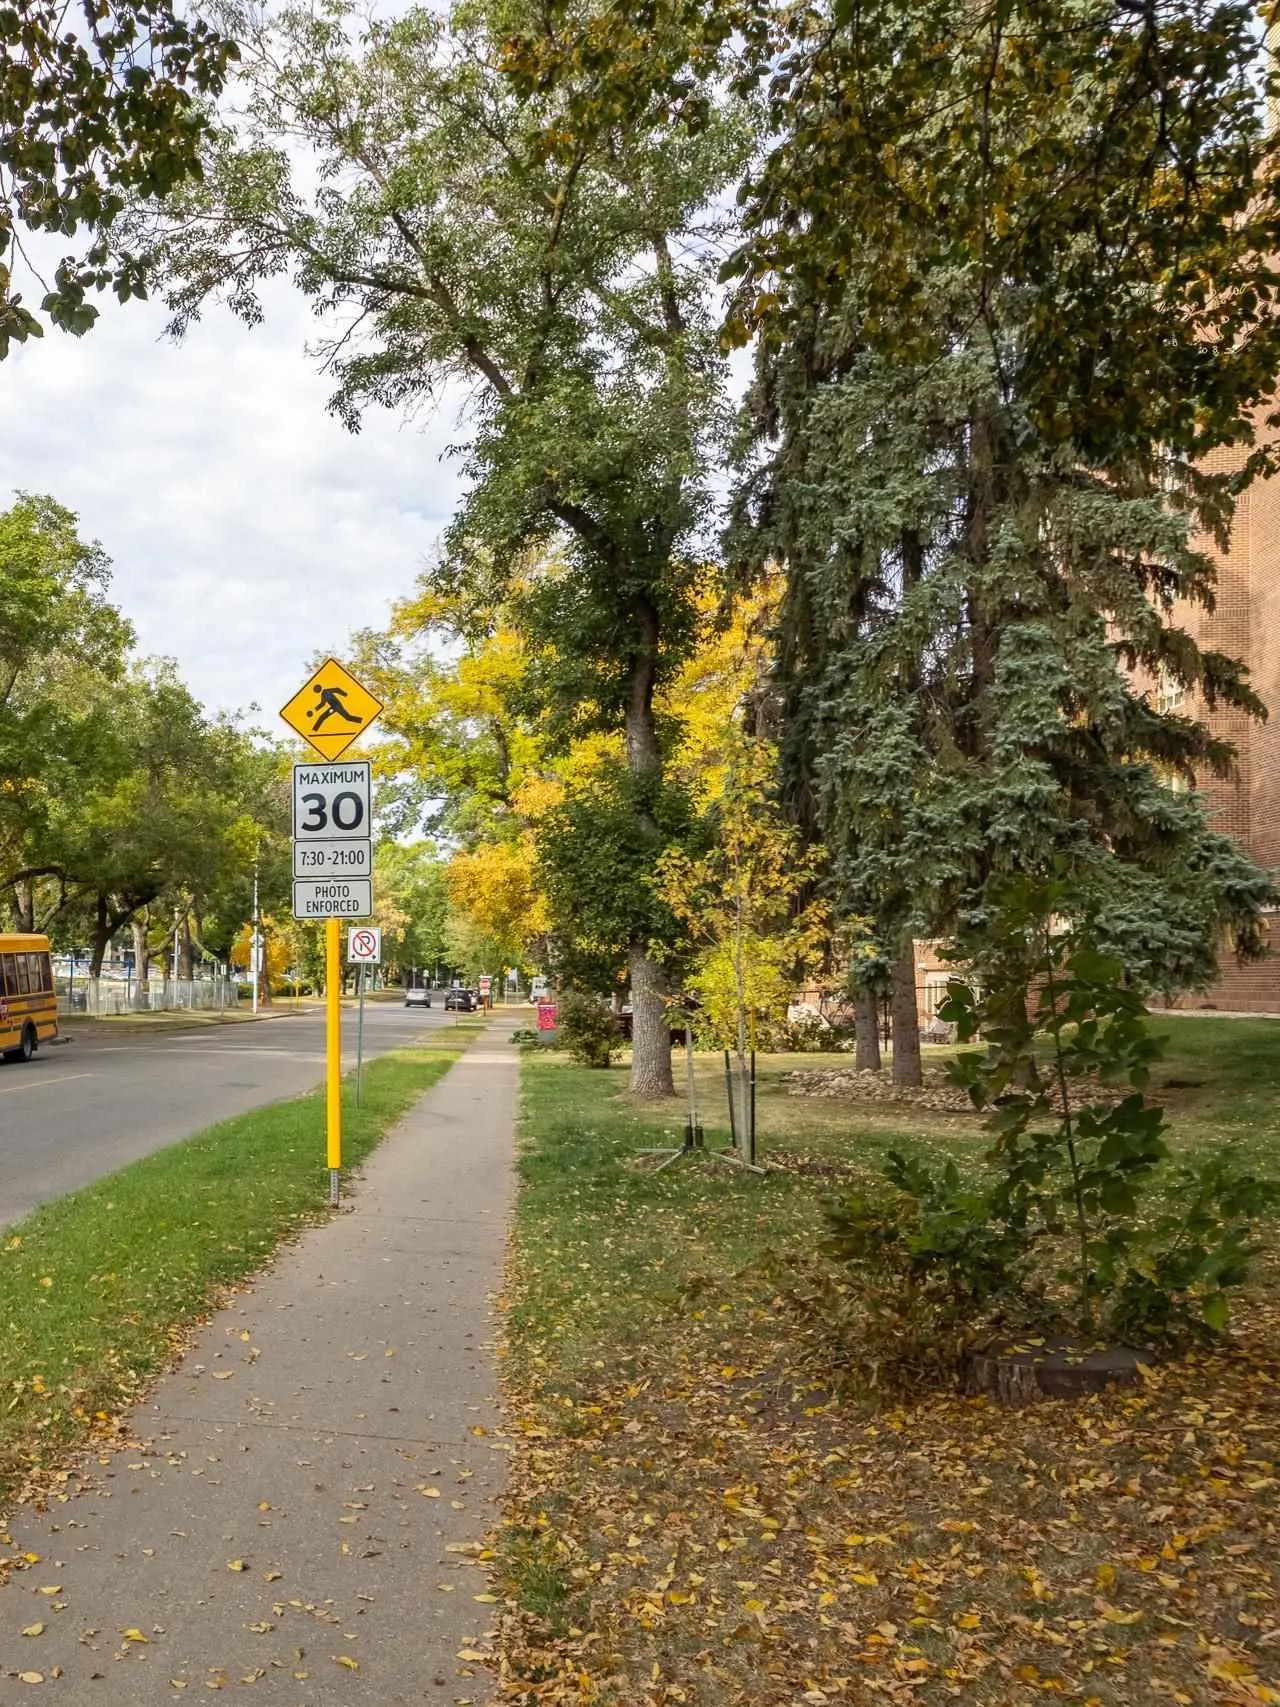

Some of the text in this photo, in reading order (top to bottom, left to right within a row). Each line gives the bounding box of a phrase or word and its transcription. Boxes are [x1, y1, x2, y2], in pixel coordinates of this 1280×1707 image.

[300, 770, 365, 785] MAXIMUM
[301, 791, 364, 832] 30
[315, 885, 350, 898] PHOTO
[306, 899, 360, 913] ENFORCED
